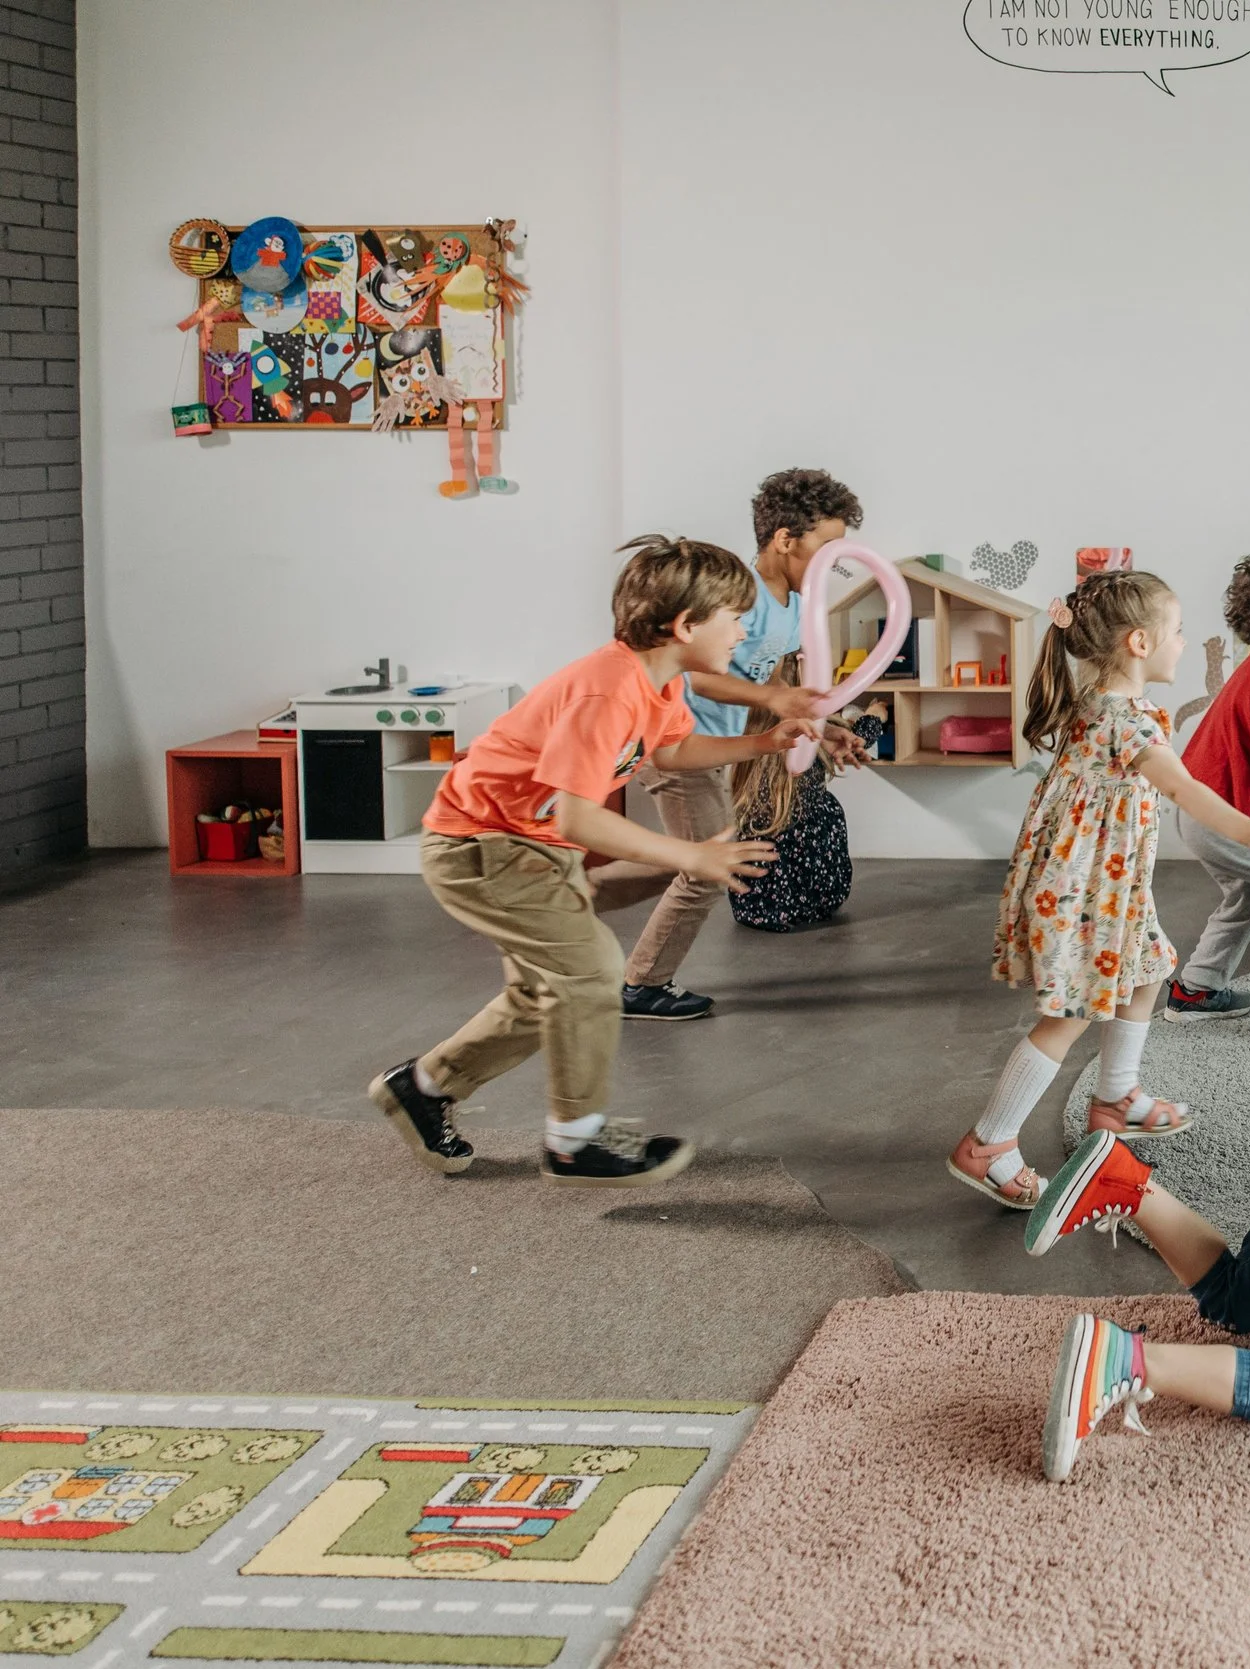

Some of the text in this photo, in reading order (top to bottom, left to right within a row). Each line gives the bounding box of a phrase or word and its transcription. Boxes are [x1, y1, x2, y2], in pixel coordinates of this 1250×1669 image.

[1000, 0, 1026, 19] AM
[1083, 0, 1153, 19] YOUNG
[1001, 27, 1220, 50] TO KNOW EVERYTHING.
